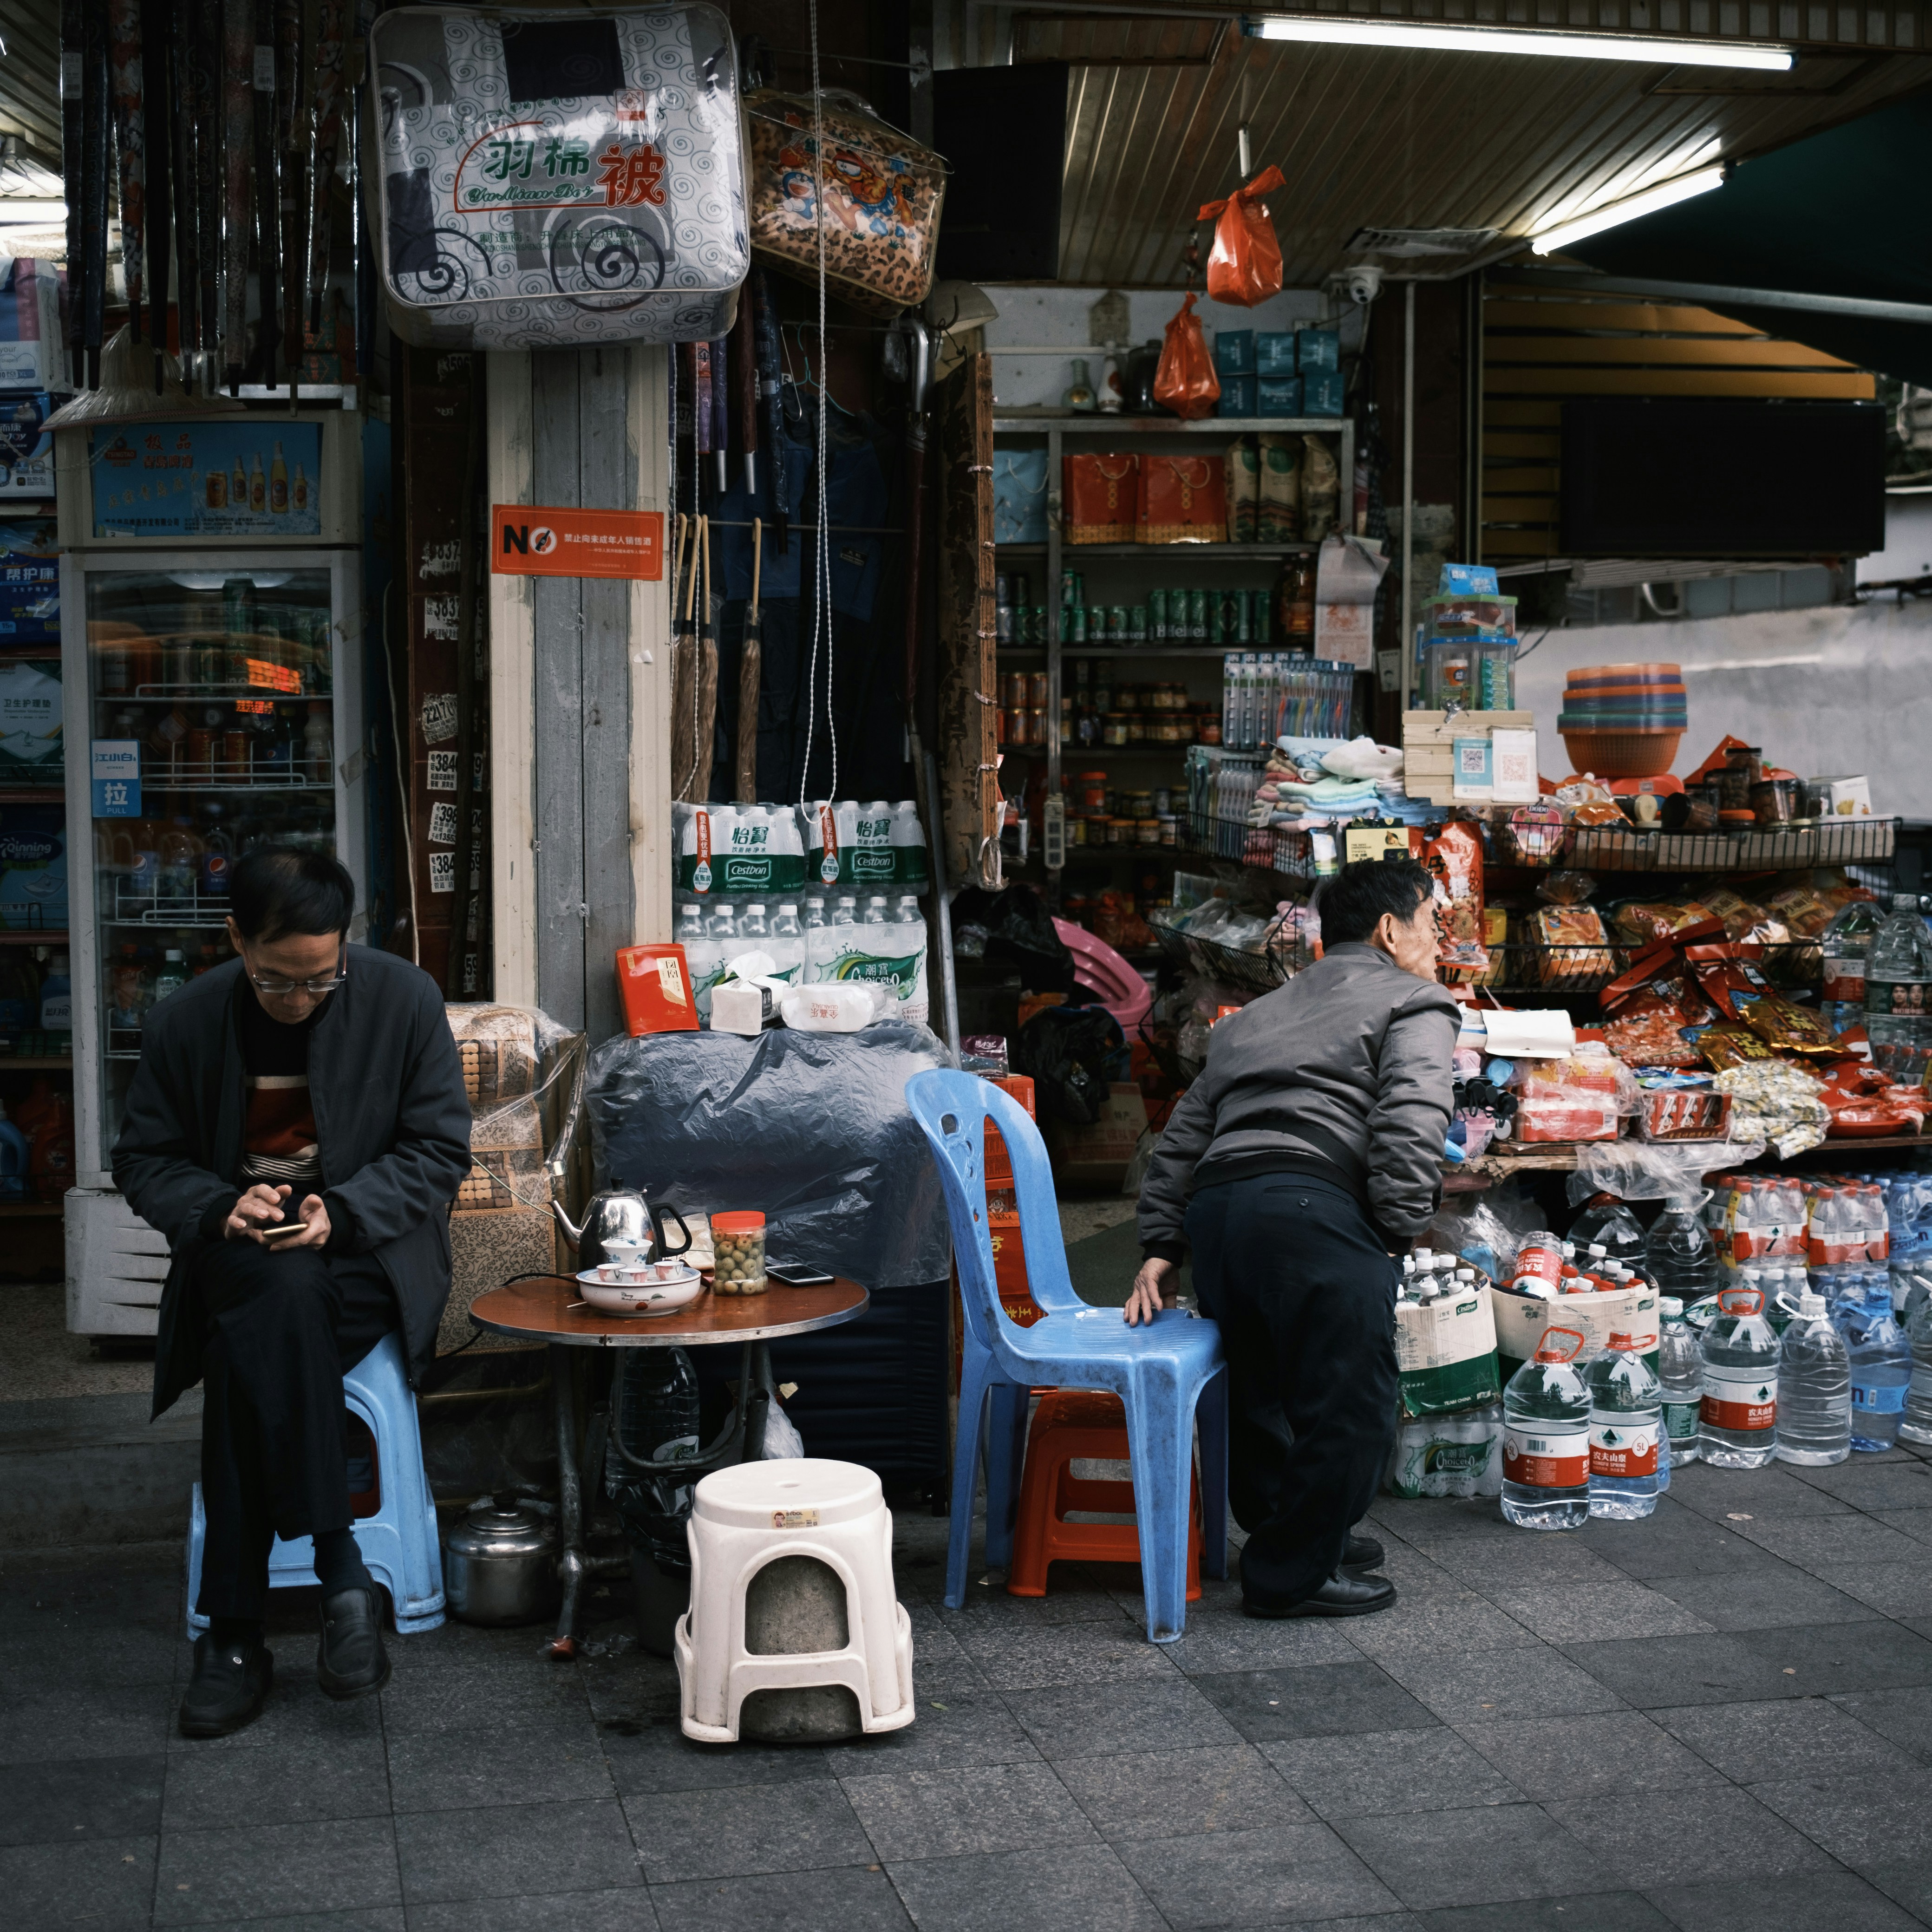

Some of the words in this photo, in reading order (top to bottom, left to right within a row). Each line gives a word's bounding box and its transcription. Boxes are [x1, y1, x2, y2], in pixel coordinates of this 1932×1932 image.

[484, 138, 667, 209] 羽棉被
[436, 754, 457, 772] 384
[104, 783, 128, 805] 拉
[699, 814, 709, 858] 整包更优惠
[7, 840, 52, 854] Qinning
[1508, 1445, 1515, 1456] 5L
[1637, 1442, 1645, 1451] 5L
[1593, 1450, 1626, 1462] 农夫山泉
